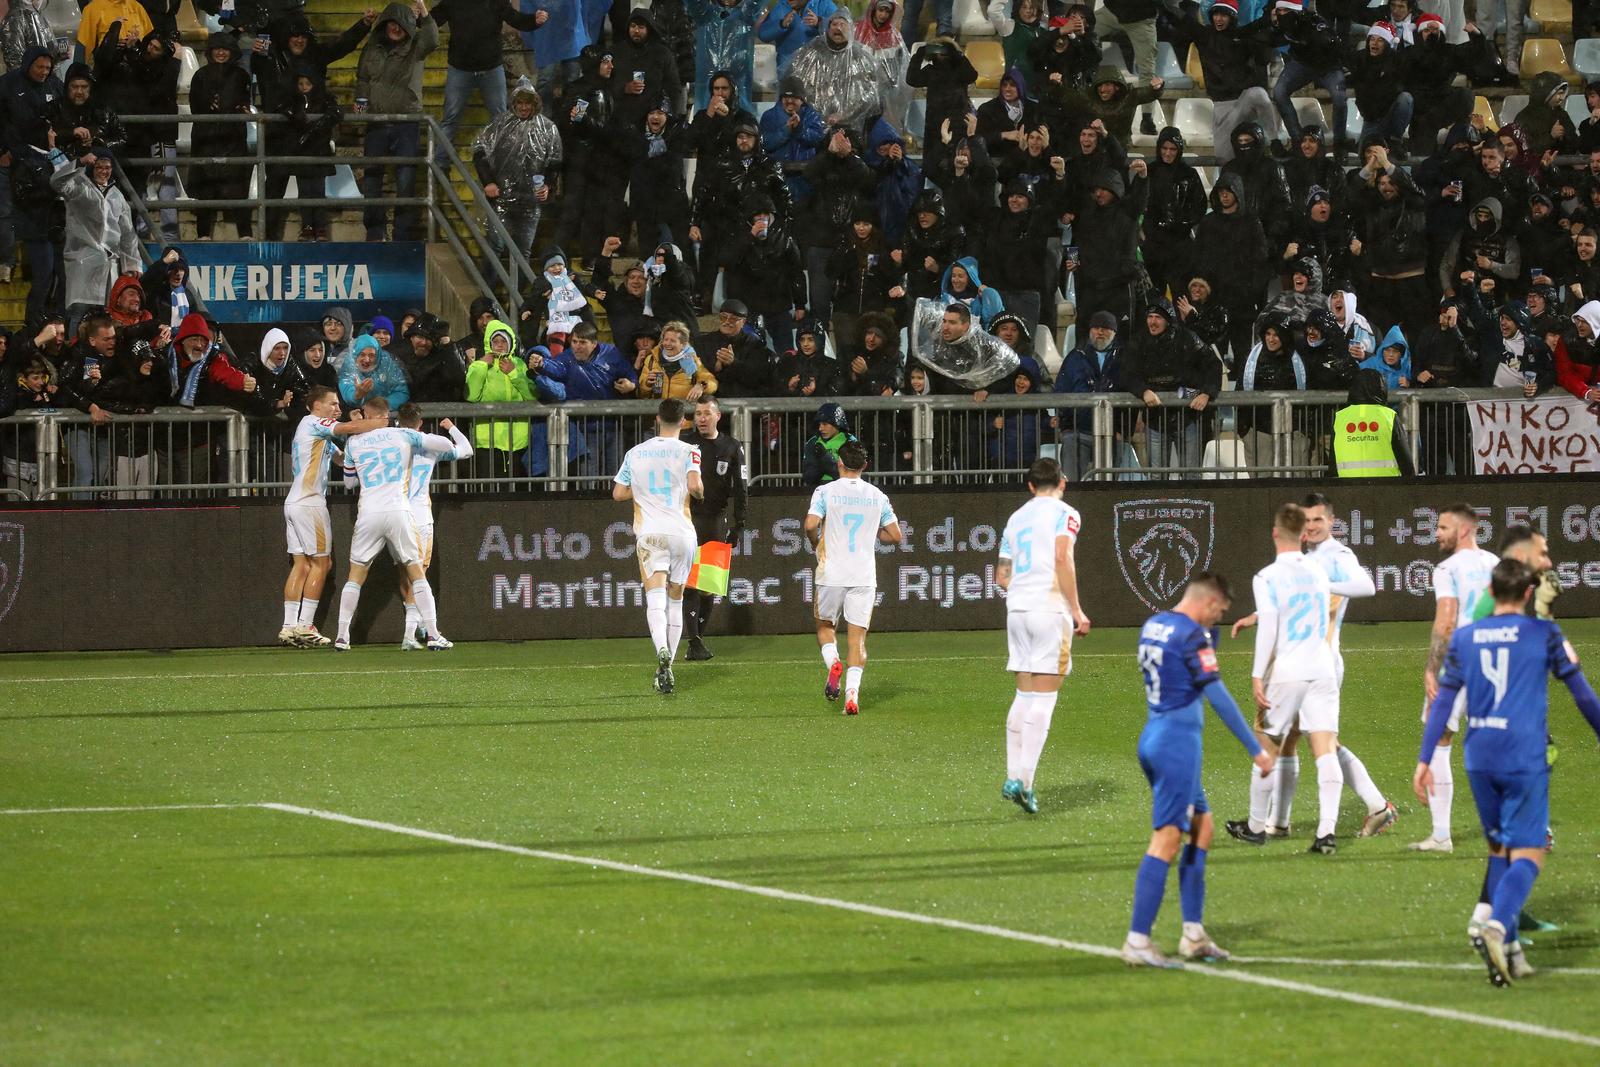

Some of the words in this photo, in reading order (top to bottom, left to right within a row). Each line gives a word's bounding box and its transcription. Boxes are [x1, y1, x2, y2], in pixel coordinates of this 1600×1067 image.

[189, 265, 237, 301] NK
[247, 264, 374, 301] RIJEKA
[1476, 402, 1570, 431] NIKO
[1346, 434, 1379, 443] Securitas
[358, 447, 403, 488] 28
[648, 469, 673, 506] 4
[843, 513, 865, 552] 7
[1122, 508, 1205, 521] PEUGEOT
[1388, 506, 1493, 546] +35
[477, 524, 591, 561] Auto
[899, 564, 1008, 608] Rijek
[1287, 592, 1326, 641] 21
[1479, 647, 1510, 711] 4
